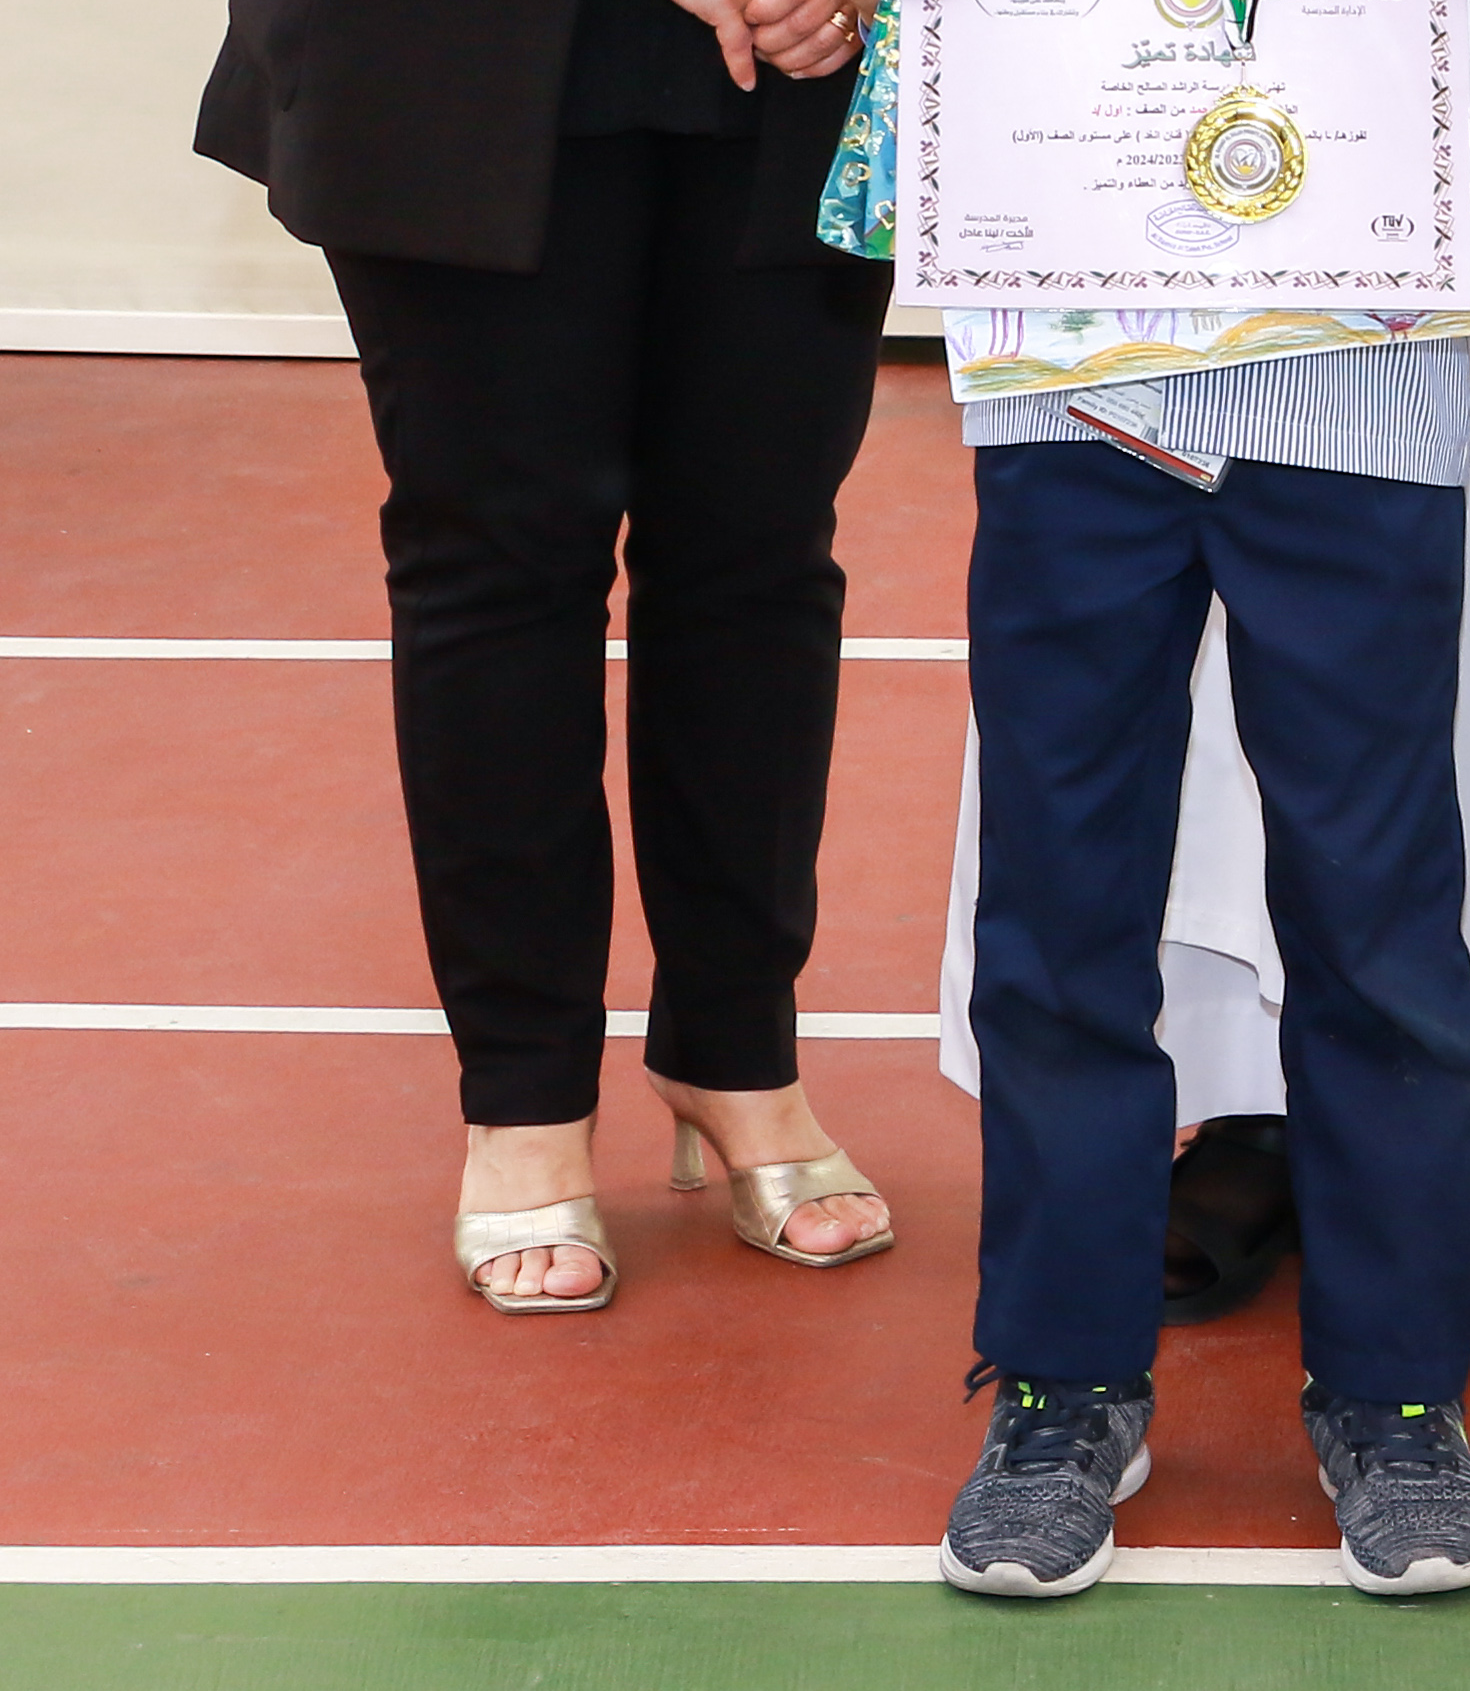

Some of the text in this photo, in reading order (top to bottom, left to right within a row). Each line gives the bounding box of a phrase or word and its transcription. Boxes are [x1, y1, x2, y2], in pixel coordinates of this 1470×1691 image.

[1100, 79, 1134, 92] الخاصة
[1136, 81, 1168, 96] الصالح
[1170, 80, 1200, 94] الراشد
[1201, 79, 1228, 97] رسة
[1134, 103, 1167, 115] الصف
[1169, 105, 1186, 117] من
[1046, 129, 1075, 140] الصف
[1159, 179, 1175, 191] من
